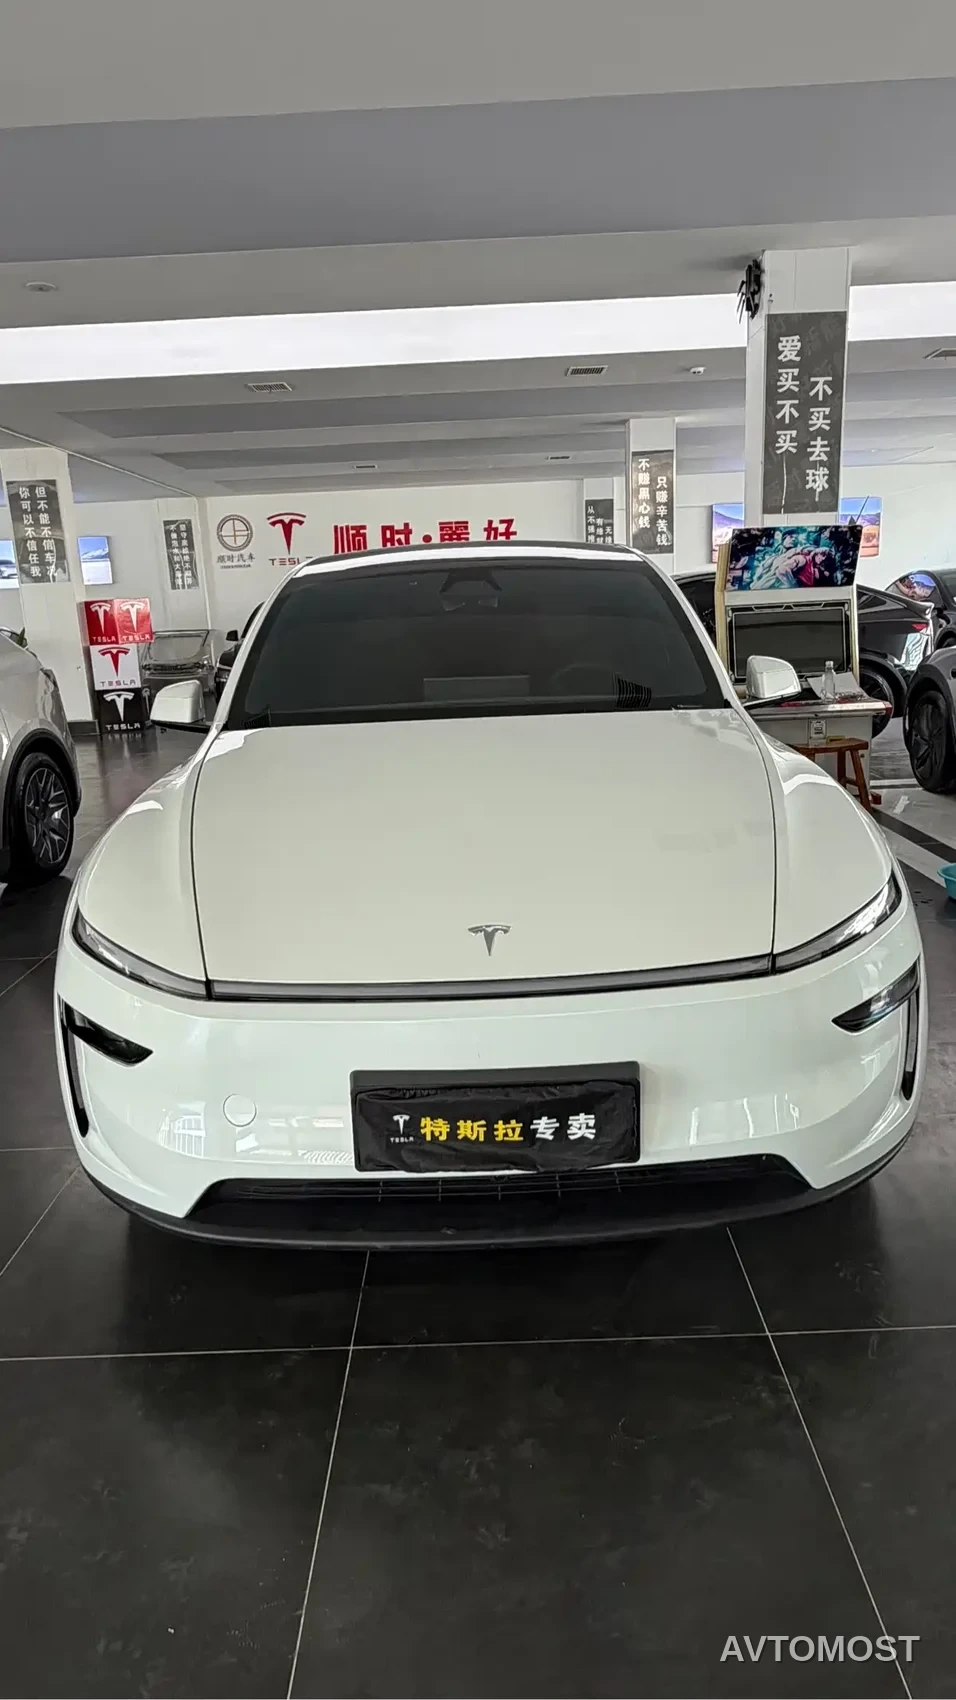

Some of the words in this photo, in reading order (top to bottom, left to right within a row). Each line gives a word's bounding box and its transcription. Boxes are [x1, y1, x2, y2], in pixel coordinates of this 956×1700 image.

[775, 334, 802, 455] 爱买不买
[805, 375, 833, 493] 不买去球
[18, 486, 42, 577] 你可以不信任我
[269, 556, 313, 569] TESL
[122, 633, 151, 641] TESLA
[100, 679, 136, 687] TESLA
[105, 723, 141, 731] TESLA
[420, 1112, 597, 1142] 特斯拉专卖
[389, 1136, 414, 1144] TESLA
